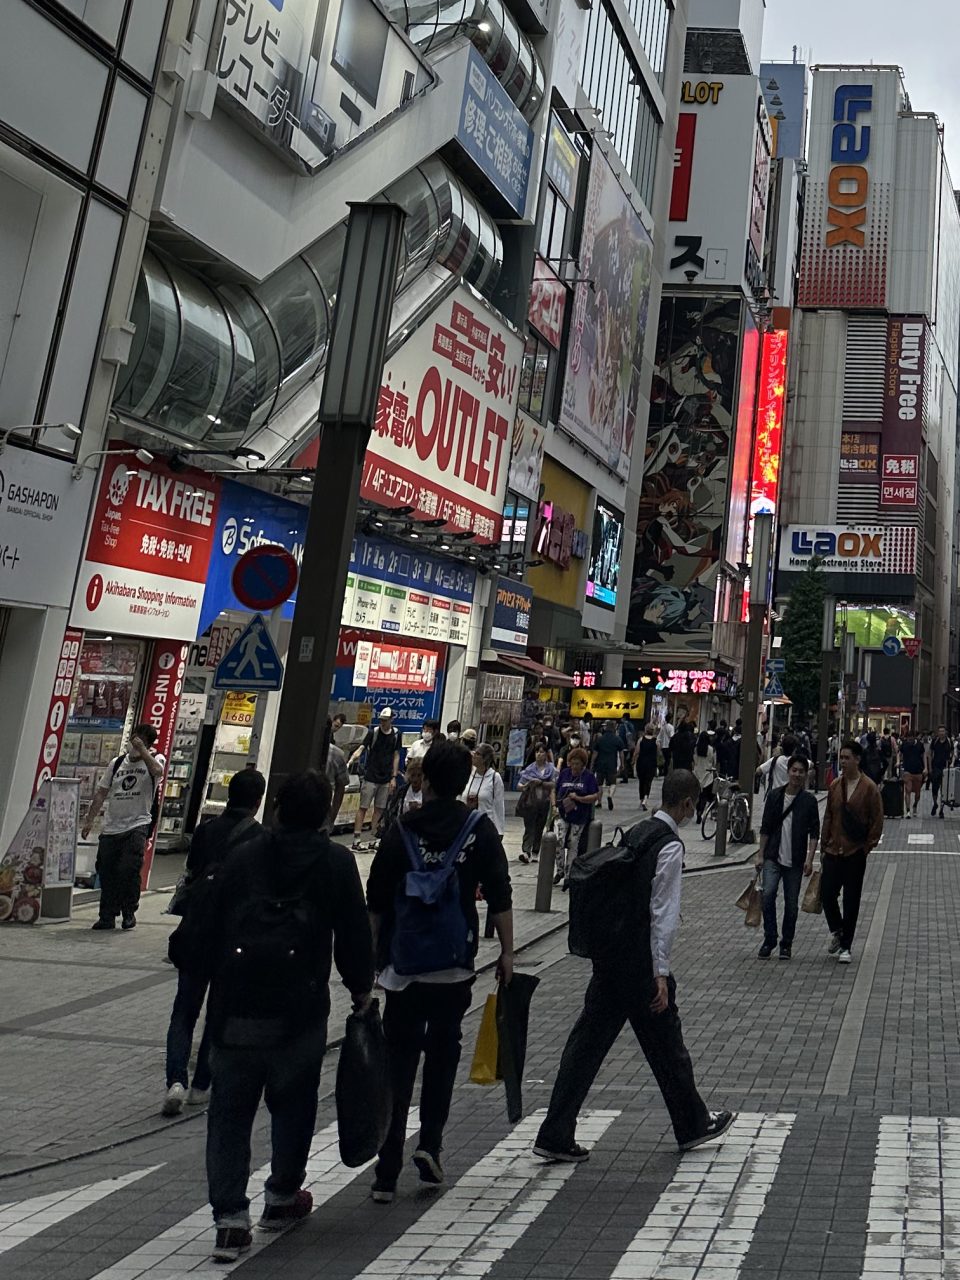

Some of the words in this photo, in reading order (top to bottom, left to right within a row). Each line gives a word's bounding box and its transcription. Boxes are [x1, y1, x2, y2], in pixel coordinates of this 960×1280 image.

[217, 36, 301, 128] レコーダー
[682, 81, 723, 105] LOT
[889, 322, 901, 365] Flagship
[899, 323, 924, 370] Duty
[485, 332, 518, 405] 安い!
[888, 366, 899, 397] Store
[898, 373, 922, 421] Free
[415, 366, 508, 497] OUTLET
[885, 459, 915, 475] 免税
[7, 483, 59, 511] GASHAPON
[135, 469, 172, 514] TAX
[170, 482, 216, 527] FREE
[104, 535, 118, 548] Shop
[362, 541, 373, 566] 1F
[387, 550, 399, 574] 2F
[411, 558, 422, 581] 3F
[434, 566, 444, 587] 4F
[861, 558, 882, 567] Store
[105, 581, 136, 598] Akihabara
[136, 586, 163, 606] Shopping
[164, 590, 197, 609] Information
[363, 696, 425, 709] パソコン・スマホ
